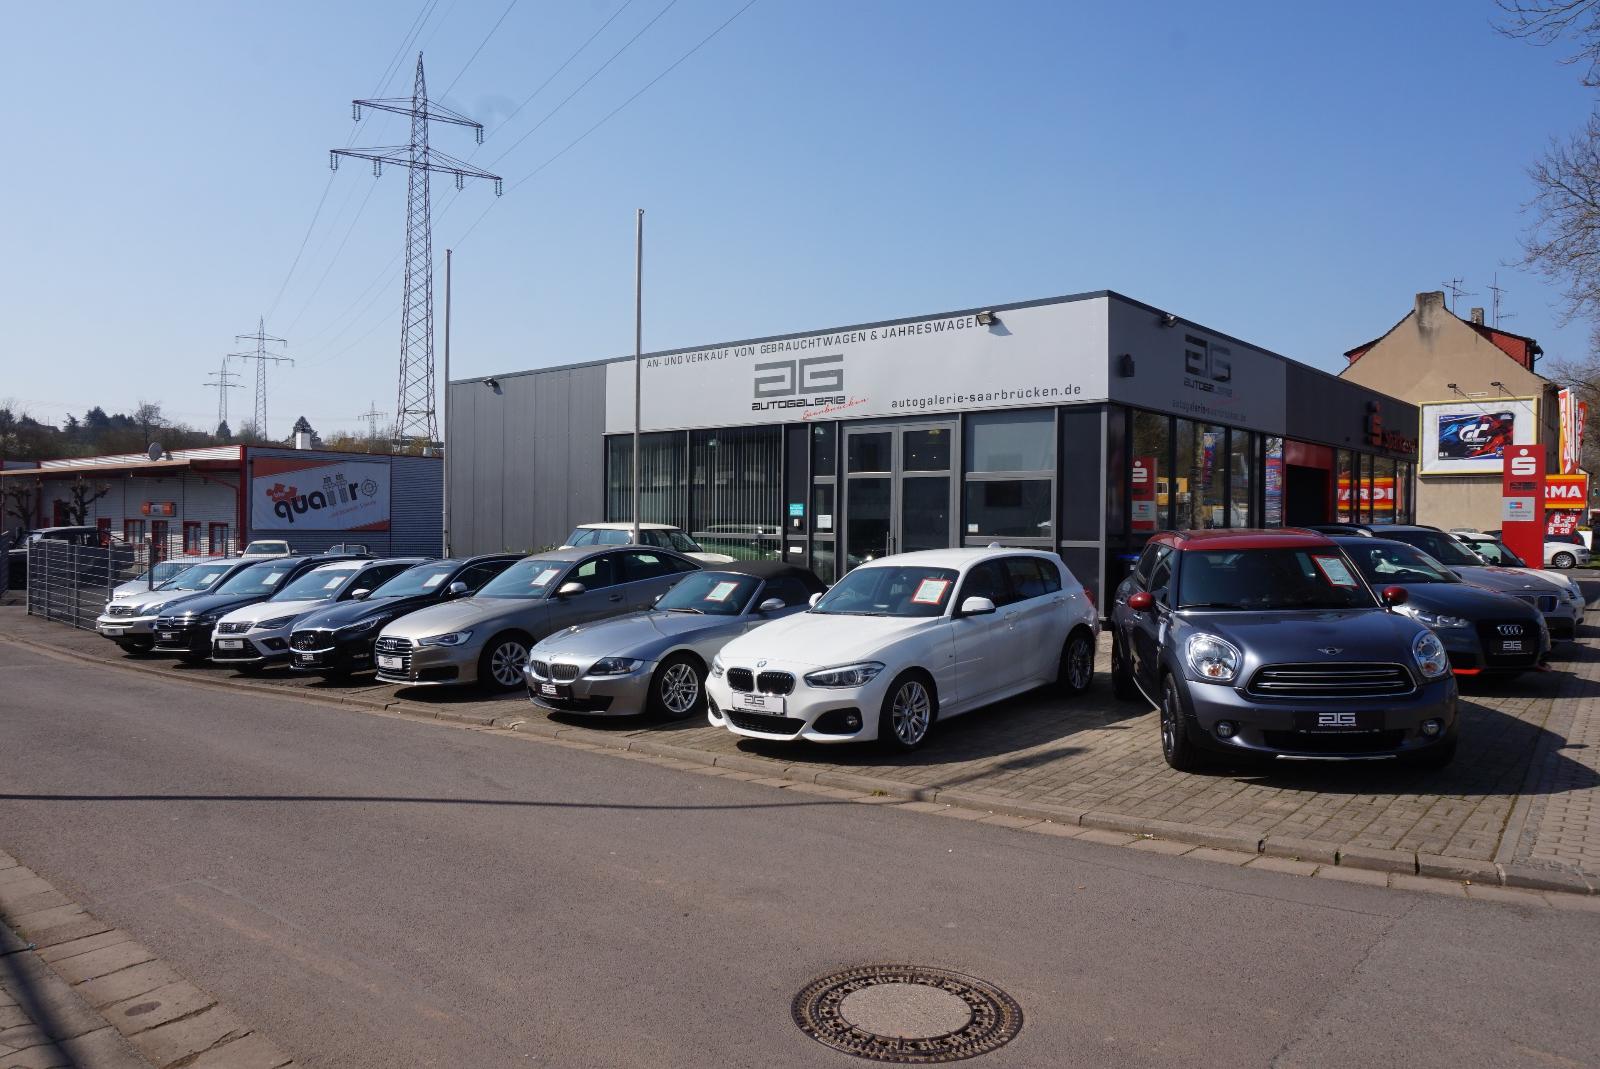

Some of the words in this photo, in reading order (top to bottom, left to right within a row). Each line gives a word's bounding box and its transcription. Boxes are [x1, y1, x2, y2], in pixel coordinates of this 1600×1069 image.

[646, 359, 662, 369] AN-
[664, 355, 683, 366] UND
[685, 349, 729, 364] VERKAUF
[734, 346, 756, 358] VON
[760, 332, 867, 355] GEBRAUCHTWAGEN
[870, 330, 878, 341] &
[891, 384, 1082, 409] autogalerie-saarbrücken.de
